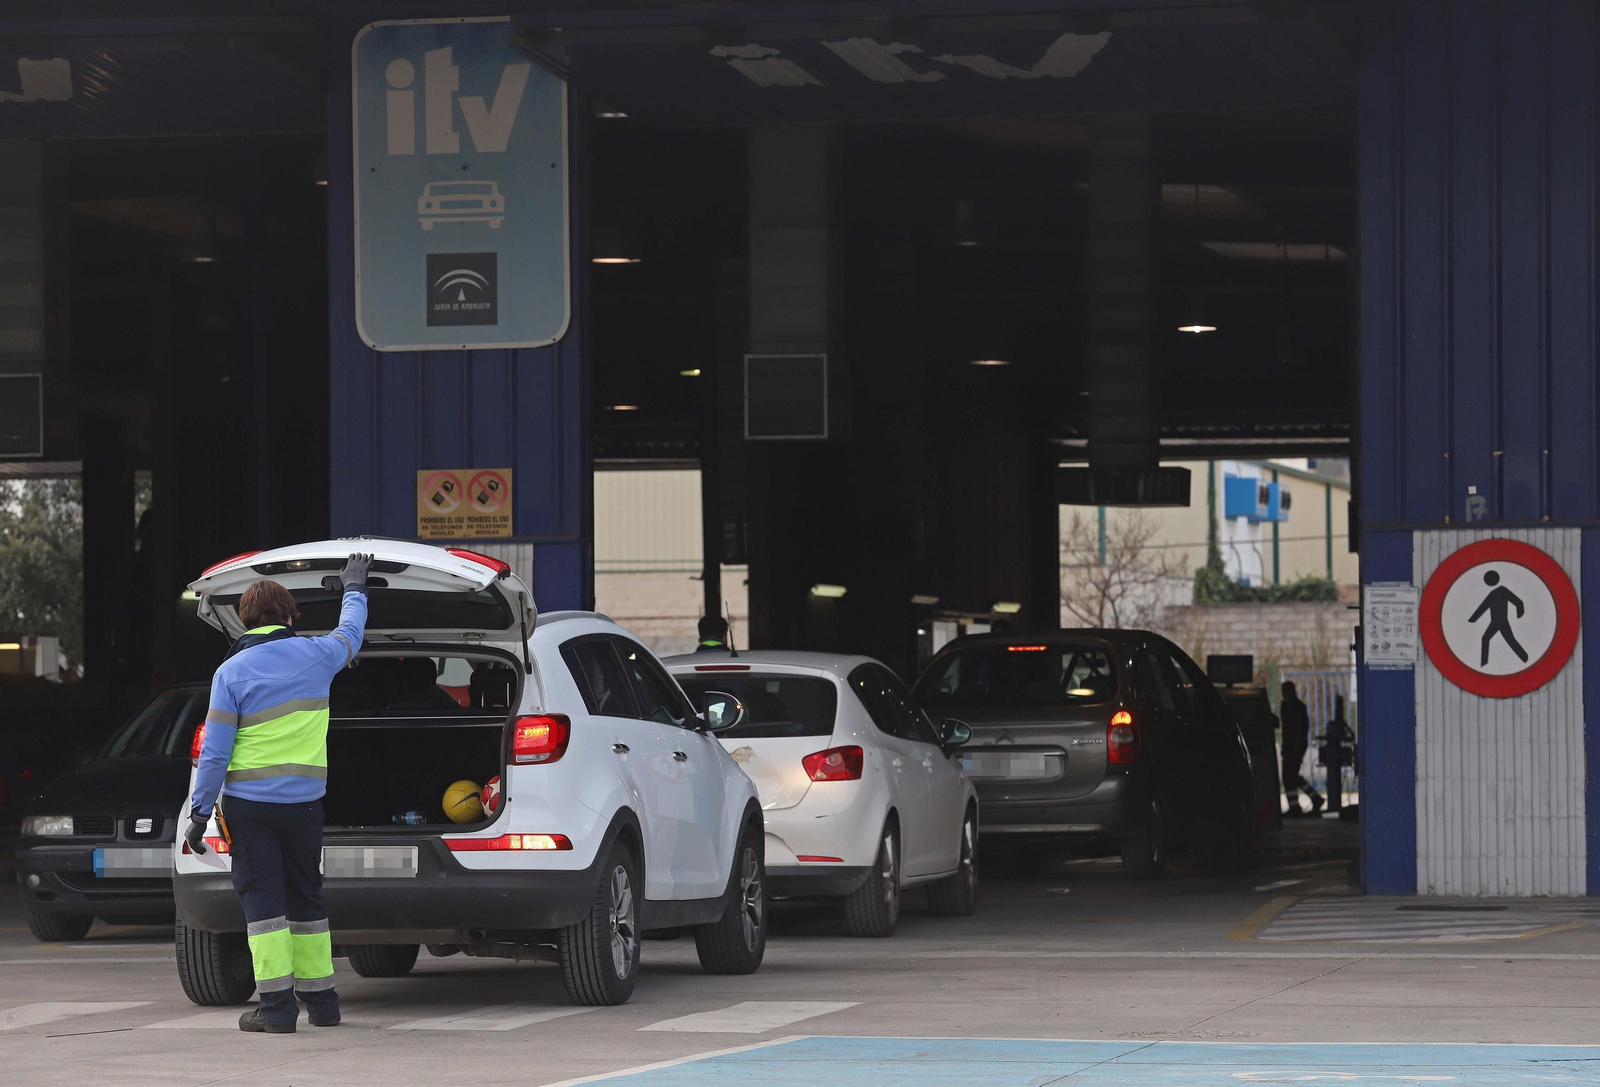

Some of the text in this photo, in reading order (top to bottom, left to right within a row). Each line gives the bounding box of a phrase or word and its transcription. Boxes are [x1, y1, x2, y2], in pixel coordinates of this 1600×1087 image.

[385, 46, 532, 155] itv
[433, 303, 451, 311] JUNTA
[452, 303, 460, 311] DE
